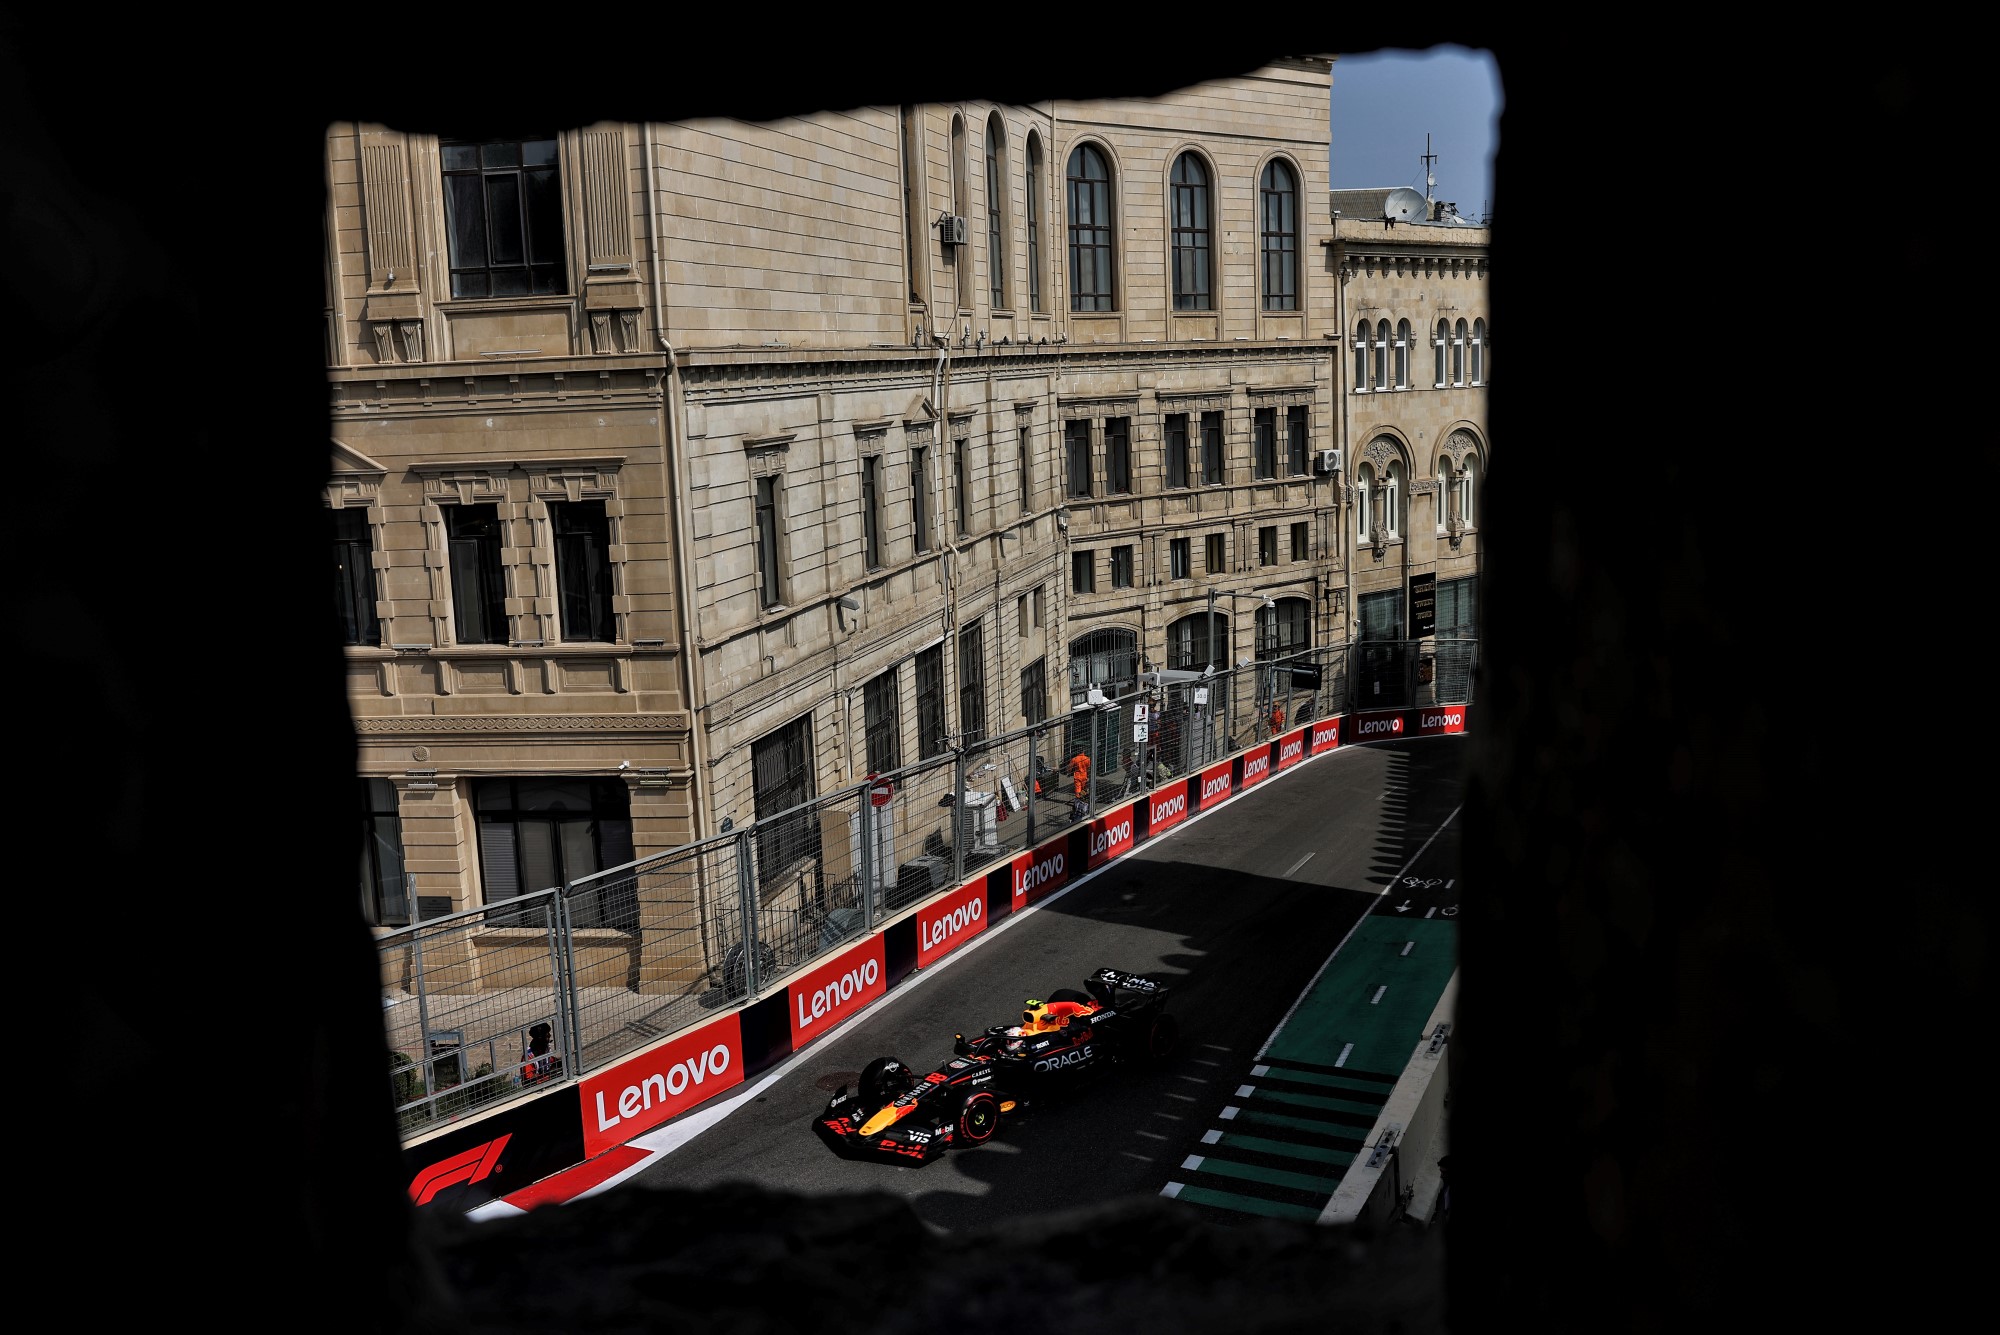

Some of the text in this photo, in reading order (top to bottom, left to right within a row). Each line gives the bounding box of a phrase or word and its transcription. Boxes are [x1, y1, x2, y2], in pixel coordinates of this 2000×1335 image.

[1358, 719, 1400, 734] Lenovo
[1422, 713, 1462, 728] Lenovo
[1313, 728, 1336, 747] Lenovo
[1280, 742, 1302, 761] Lenovo
[1244, 755, 1268, 779] Lenovo
[1203, 773, 1230, 799] Lenovo
[1151, 793, 1185, 825] Lenovo
[1091, 820, 1131, 857] Lenovo
[1015, 853, 1064, 896] Lenovo
[923, 898, 982, 952] Lenovo
[798, 958, 879, 1028] Lenovo
[1090, 1010, 1117, 1024] HONDA
[1034, 1046, 1094, 1072] ORACLE
[596, 1044, 730, 1132] Lenovo
